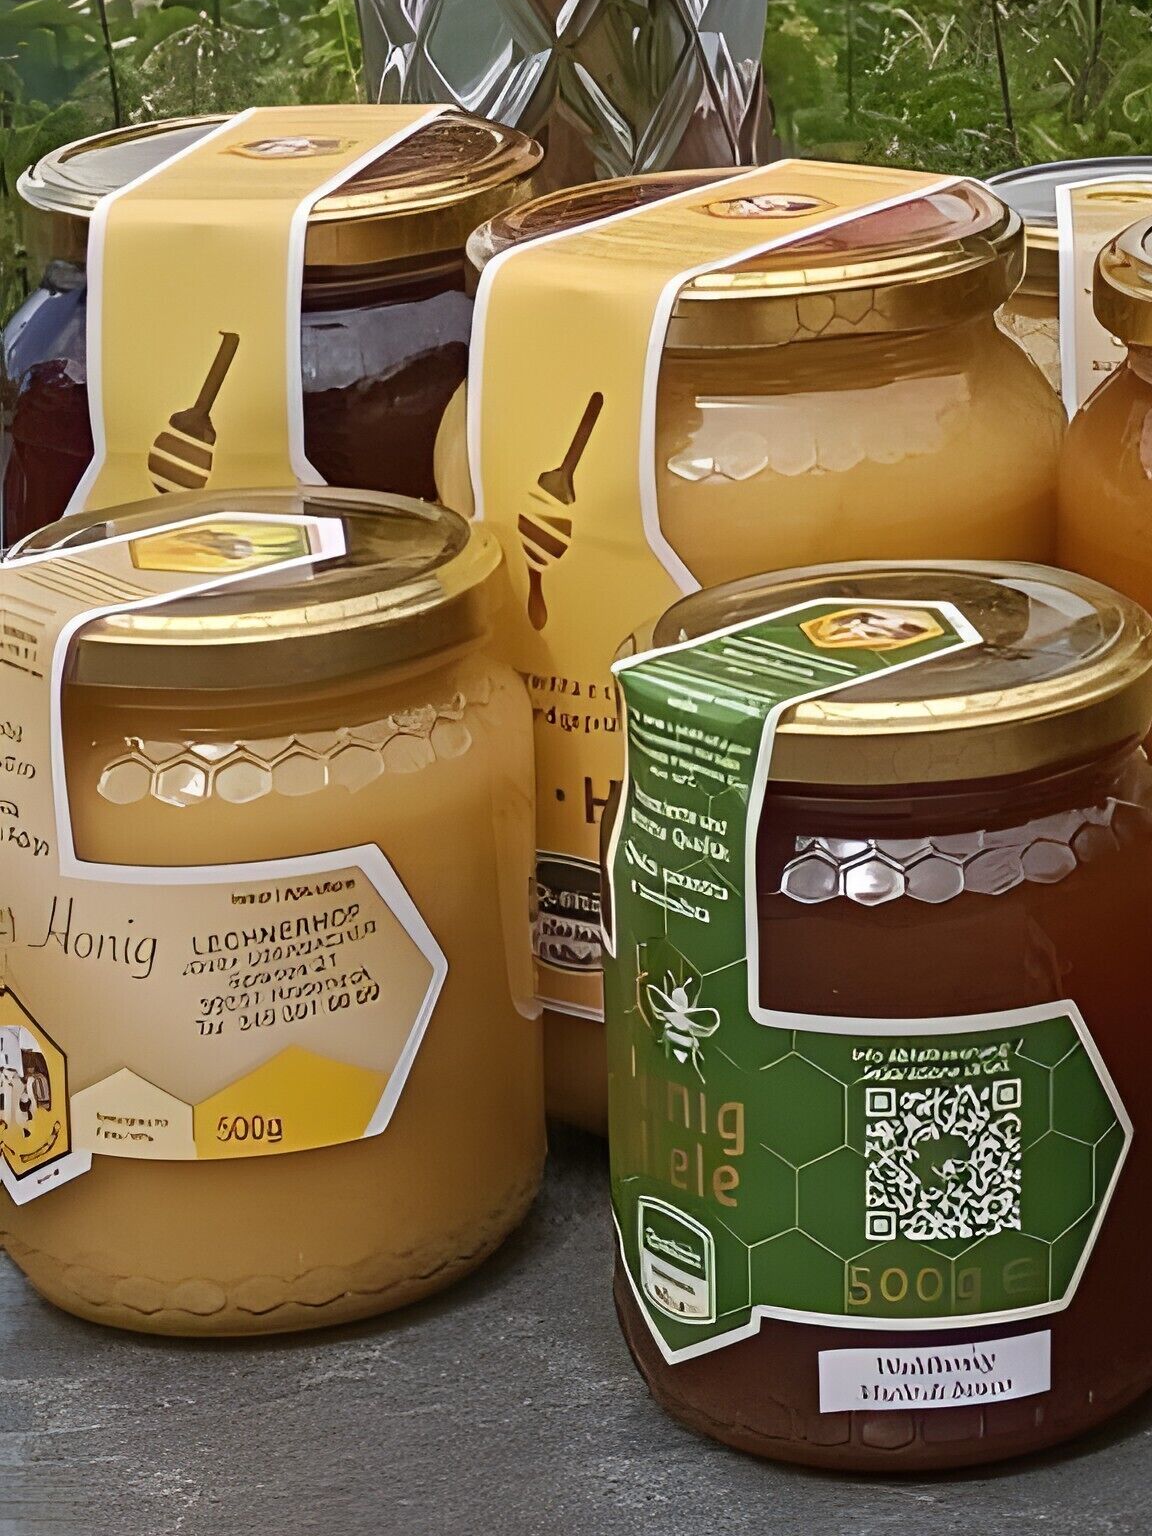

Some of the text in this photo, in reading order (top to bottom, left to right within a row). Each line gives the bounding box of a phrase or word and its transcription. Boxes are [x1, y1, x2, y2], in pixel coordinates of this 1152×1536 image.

[27, 894, 158, 980] Honig
[216, 1114, 283, 1143] 500g
[848, 1263, 982, 1307] 500g
